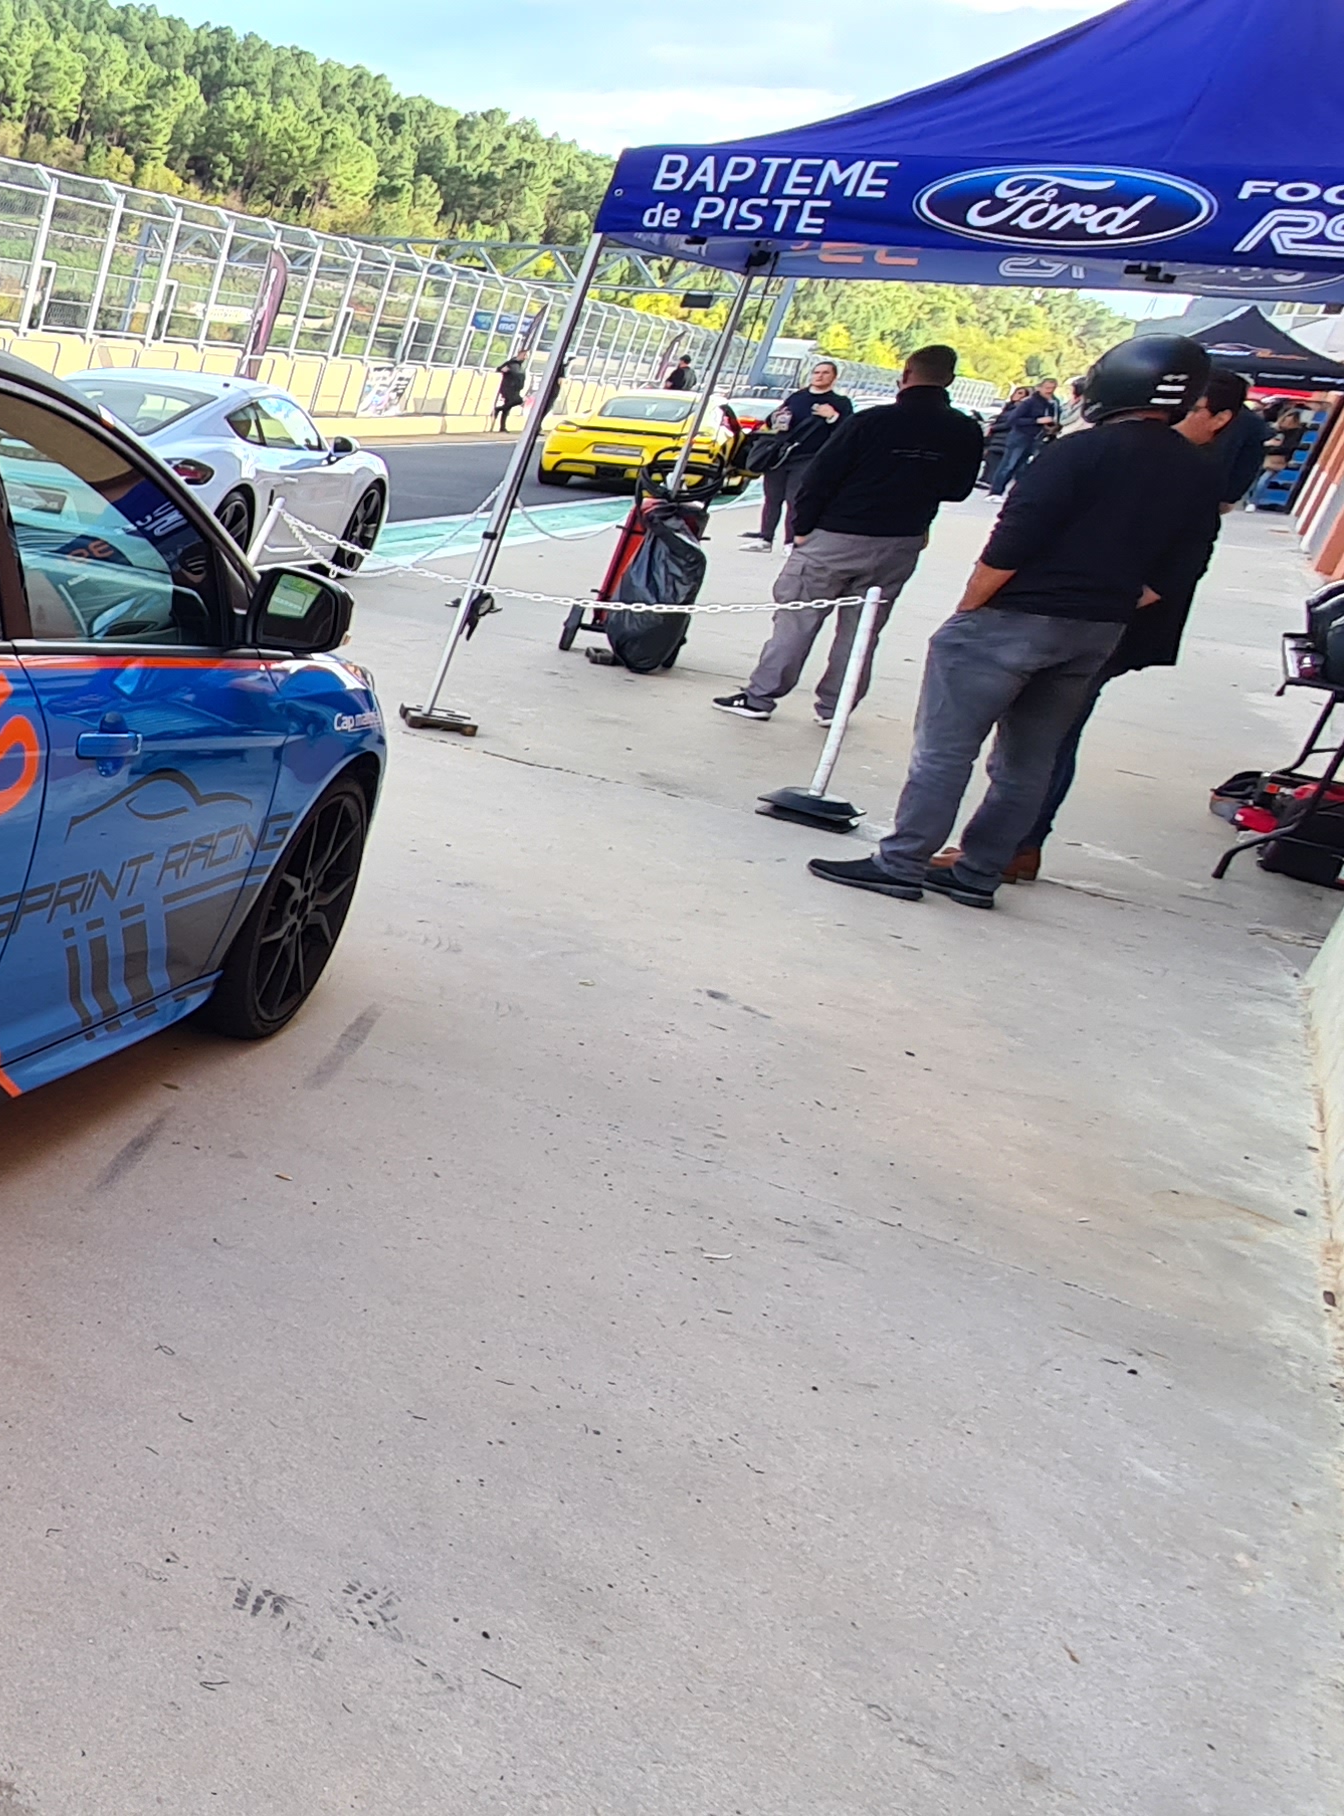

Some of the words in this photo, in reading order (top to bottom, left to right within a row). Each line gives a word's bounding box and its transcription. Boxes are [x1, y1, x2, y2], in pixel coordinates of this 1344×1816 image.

[652, 153, 900, 199] BAPTEME
[642, 202, 681, 229] de
[691, 196, 831, 235] PISTE
[965, 173, 1157, 236] Ford
